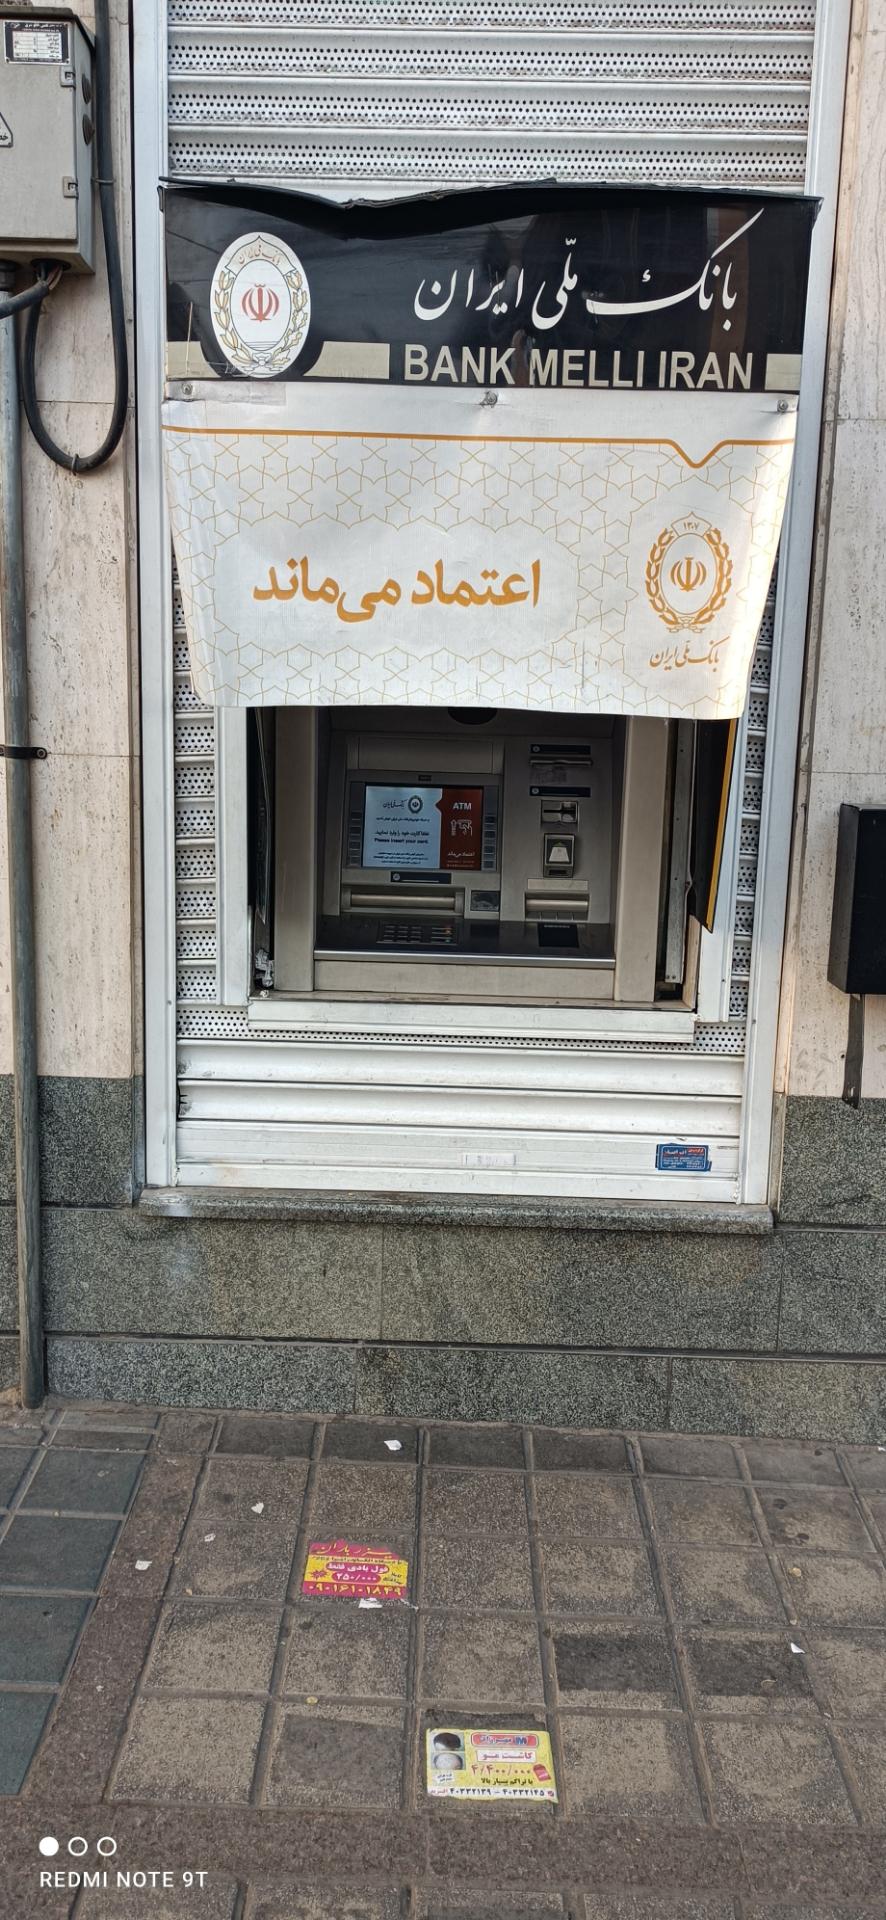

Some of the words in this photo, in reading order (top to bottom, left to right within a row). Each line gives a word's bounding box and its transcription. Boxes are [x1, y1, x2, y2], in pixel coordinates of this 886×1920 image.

[586, 207, 765, 332] بانک
[413, 268, 525, 321] ایران
[404, 344, 516, 385] BANK
[529, 348, 645, 388] MELLI
[658, 351, 754, 390] IRAN
[411, 558, 541, 608] اعتماد
[650, 646, 678, 670] ایران
[688, 635, 730, 672] بانک
[452, 802, 472, 811] ATM
